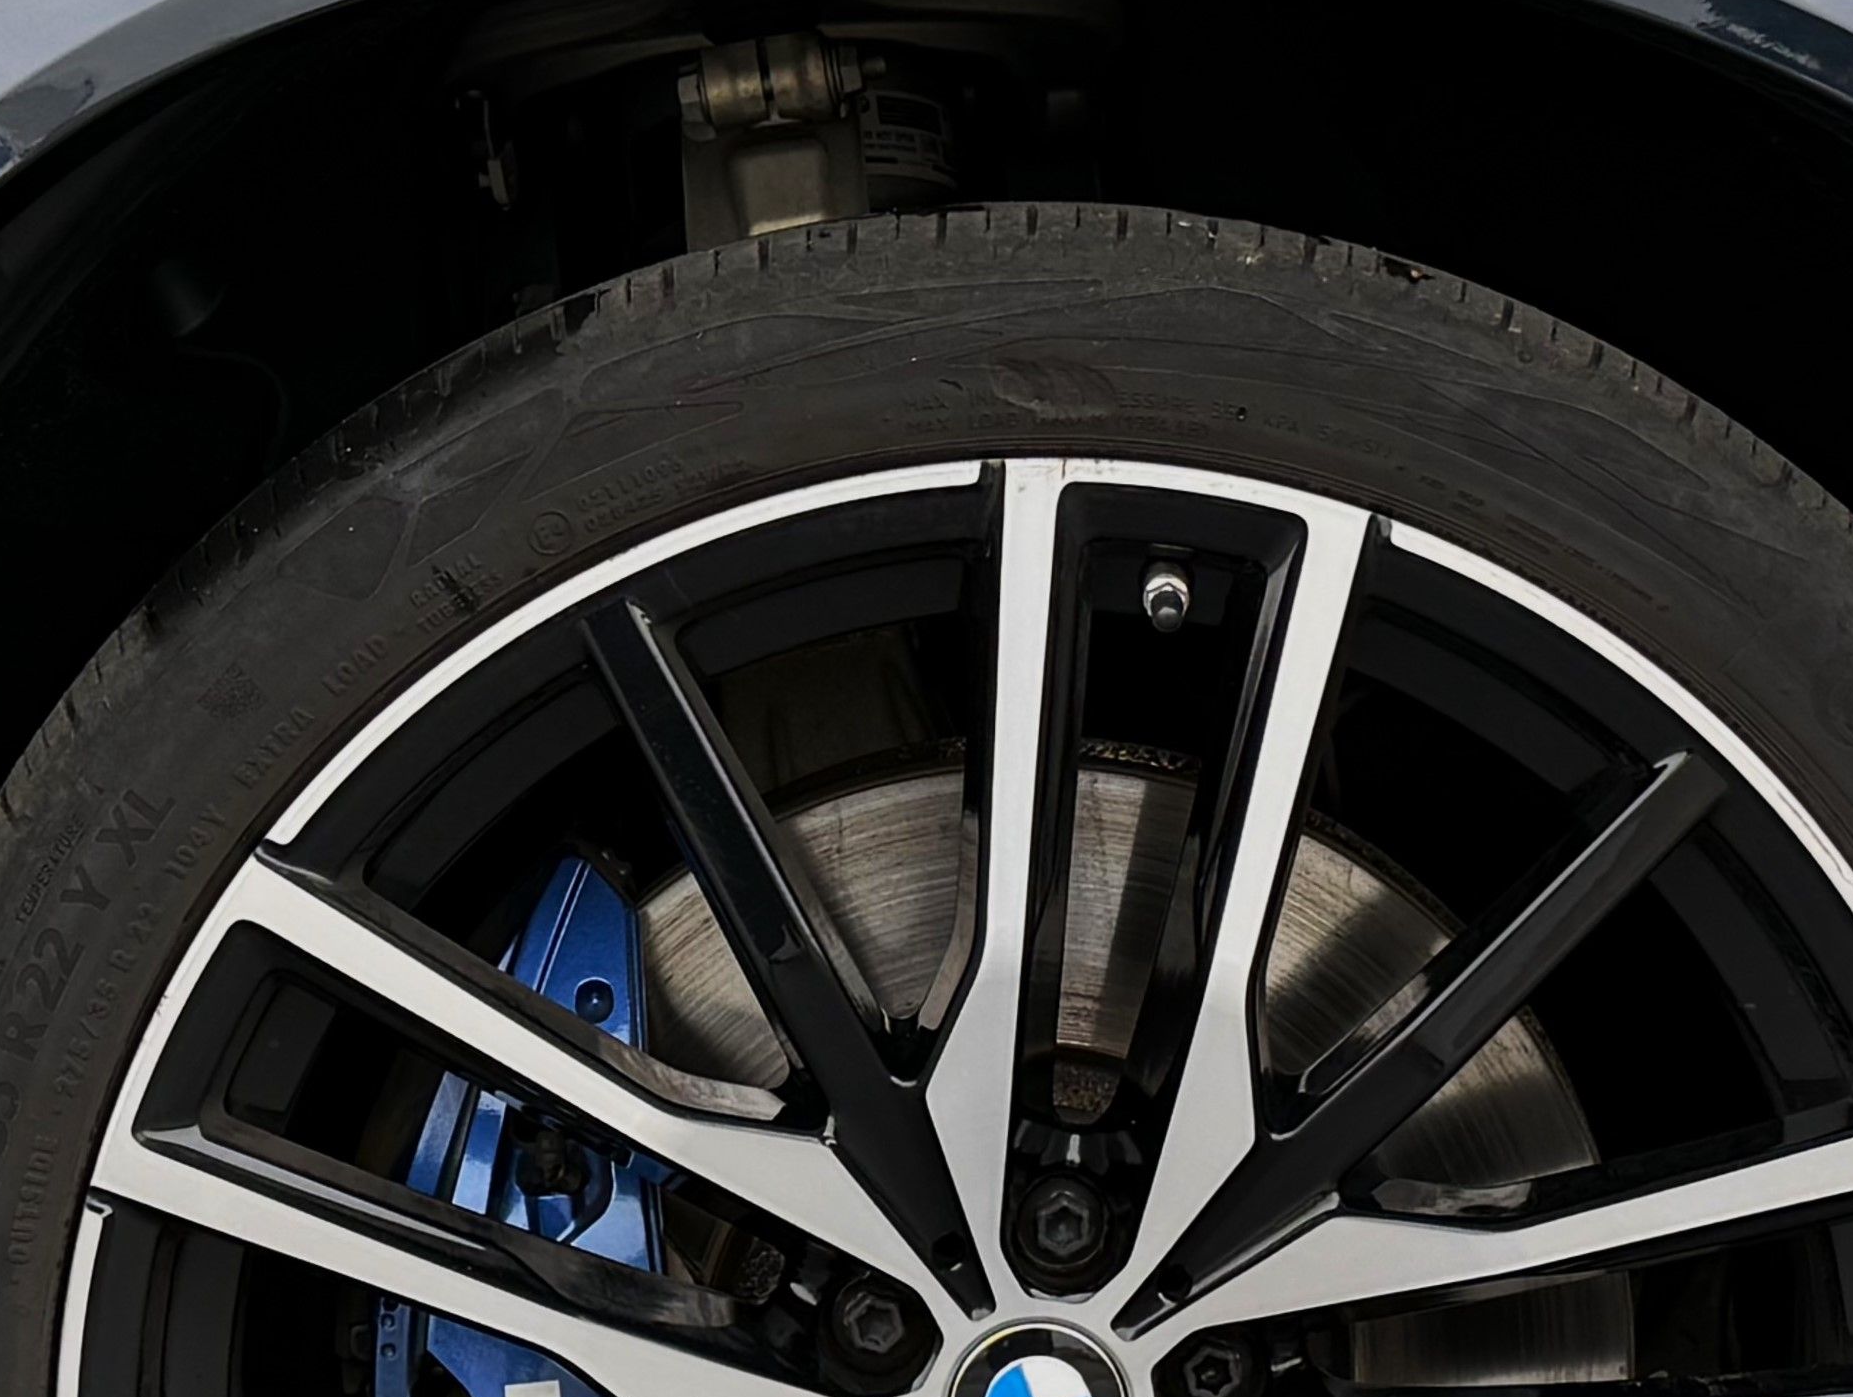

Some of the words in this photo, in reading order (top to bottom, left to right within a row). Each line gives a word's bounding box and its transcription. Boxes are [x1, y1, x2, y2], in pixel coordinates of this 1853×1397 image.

[59, 868, 115, 922] Y
[95, 788, 175, 868] XL
[9, 1134, 59, 1266] OUTSIDE
